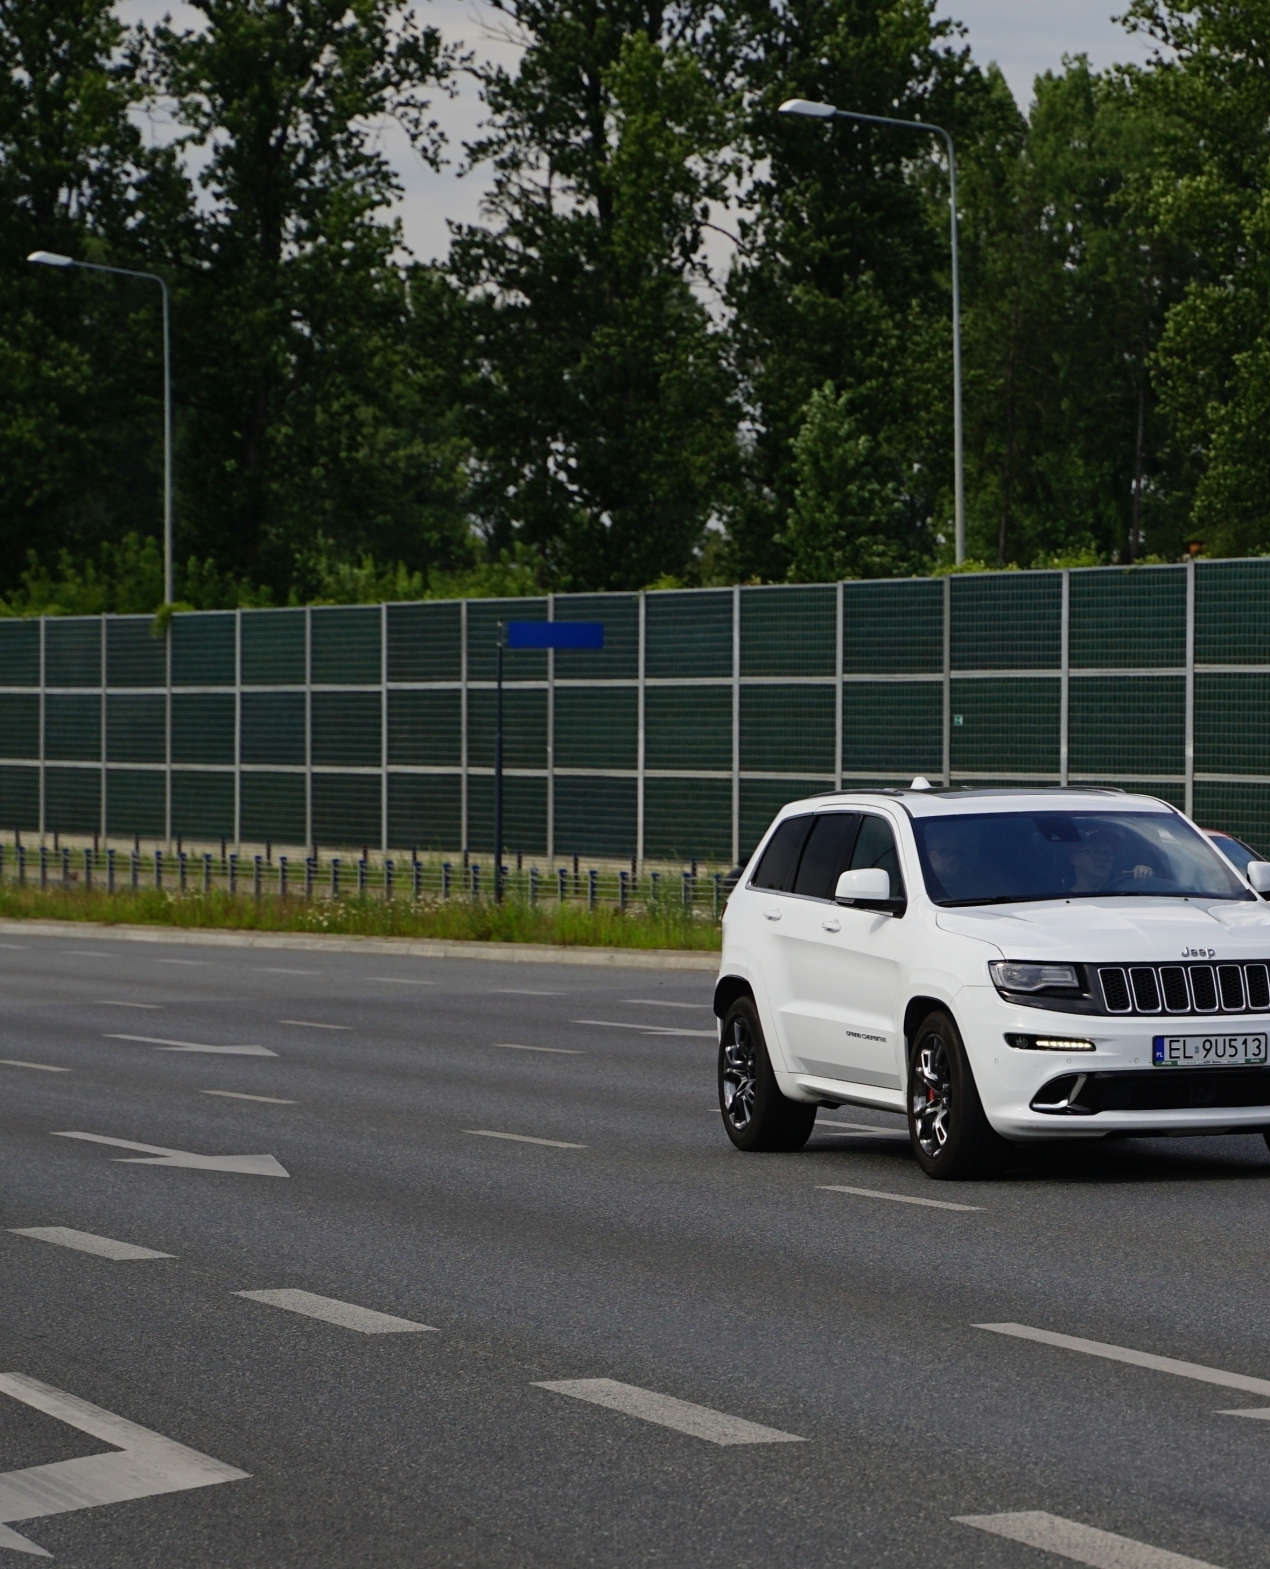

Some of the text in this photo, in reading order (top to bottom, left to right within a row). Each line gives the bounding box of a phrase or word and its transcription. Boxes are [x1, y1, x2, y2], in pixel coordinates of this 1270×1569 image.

[1180, 946, 1215, 959] Jeep
[1169, 1037, 1262, 1059] EL 9U513
